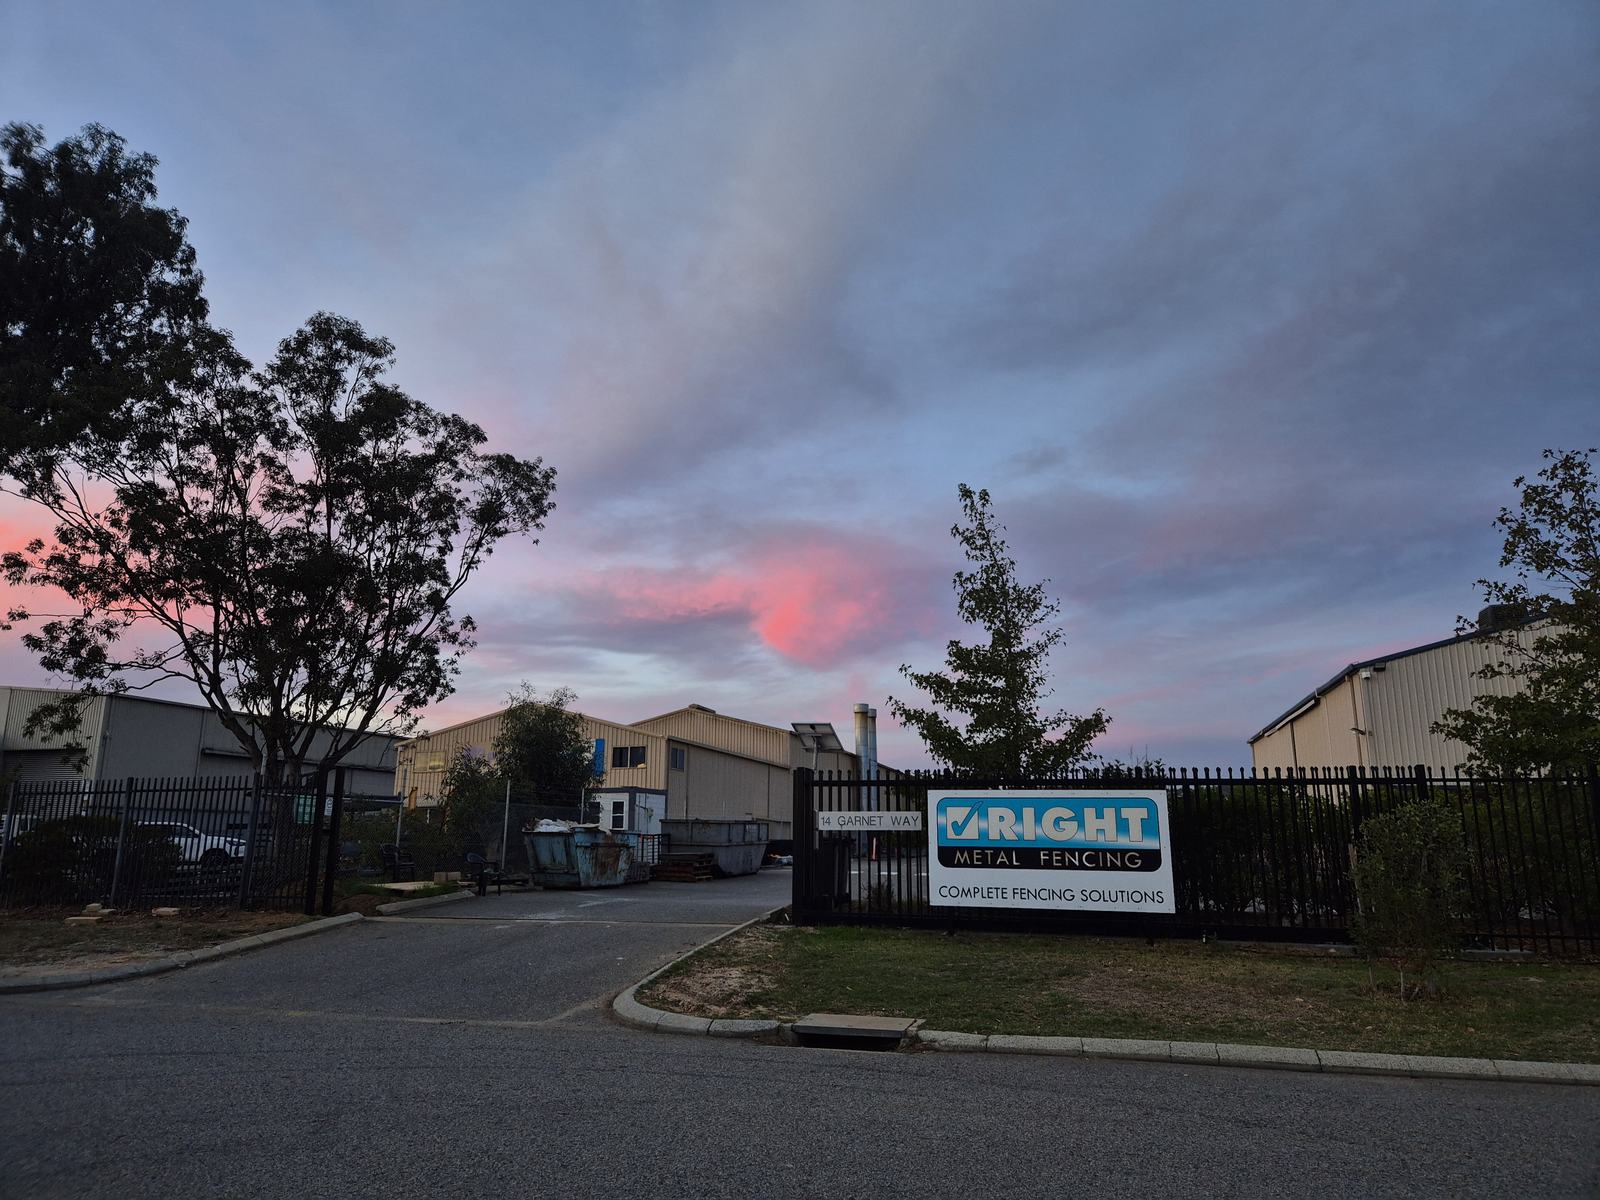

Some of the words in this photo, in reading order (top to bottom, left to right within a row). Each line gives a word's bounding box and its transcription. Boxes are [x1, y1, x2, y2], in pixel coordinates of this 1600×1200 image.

[821, 816, 832, 827] 14
[837, 816, 884, 827] GARNET
[890, 816, 919, 827] WAY
[987, 806, 1149, 842] RIGHT
[954, 849, 1021, 866] METAL
[1040, 850, 1142, 869] FENCING
[938, 885, 1008, 900] COMPLETE
[1012, 887, 1076, 902] FENCING
[1080, 889, 1165, 904] SOLUTIONS
